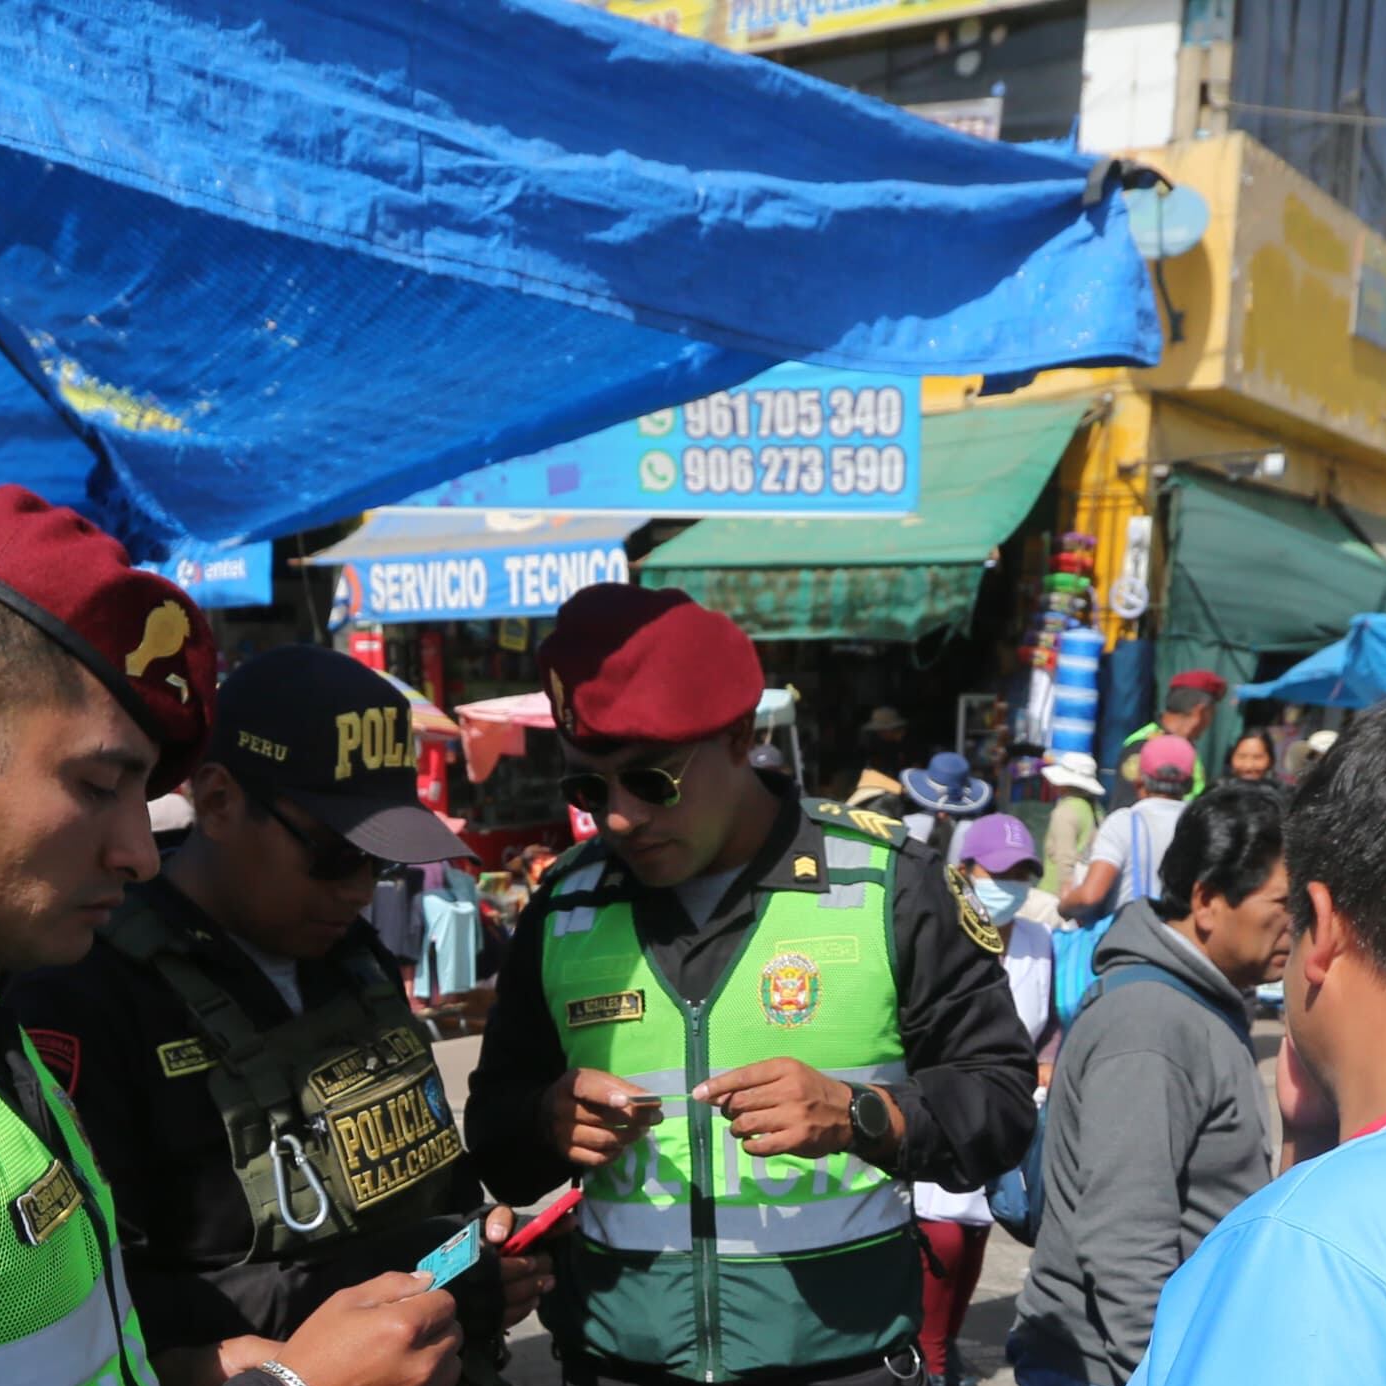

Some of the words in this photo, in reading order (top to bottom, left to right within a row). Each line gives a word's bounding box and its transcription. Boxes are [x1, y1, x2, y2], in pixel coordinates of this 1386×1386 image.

[684, 388, 751, 438] 961
[754, 388, 823, 438] 705
[828, 386, 903, 438] 340
[683, 446, 754, 493] 906
[760, 446, 825, 494] 273
[830, 445, 906, 494] 590
[369, 558, 488, 612] SERVICIO
[504, 549, 630, 607] TECNICO
[237, 730, 288, 762] PERU
[335, 1085, 437, 1170] POLICIA
[350, 1124, 461, 1201] HALCONES
